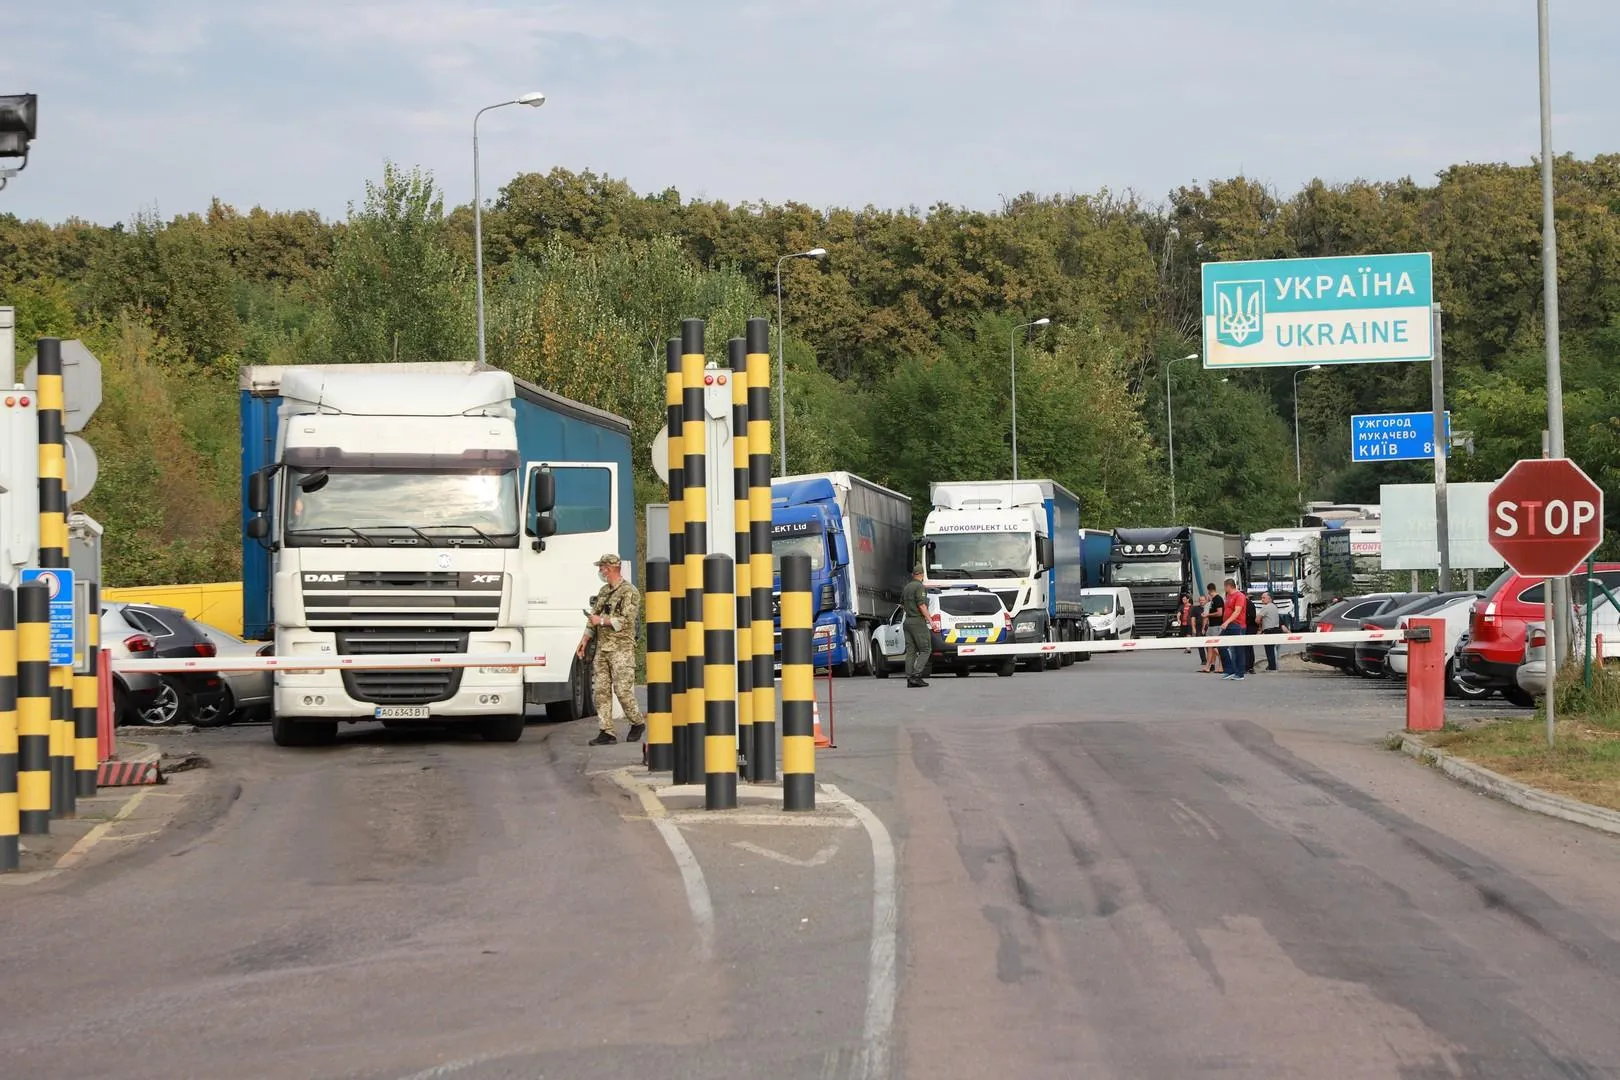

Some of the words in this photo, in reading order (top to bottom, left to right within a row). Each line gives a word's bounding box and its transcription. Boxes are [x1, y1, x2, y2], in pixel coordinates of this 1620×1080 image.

[1274, 266, 1415, 301] УКРАЇНА
[1276, 319, 1409, 347] UKRAINE
[1358, 418, 1412, 428] УЖГОРОД
[1359, 430, 1417, 440] МУКАЧЕВО
[1359, 441, 1398, 456] КИЇВ
[1495, 499, 1595, 537] STOP
[939, 524, 1000, 532] AUTOKOMPLEKT
[304, 574, 345, 583] DAF
[471, 574, 501, 583] XF
